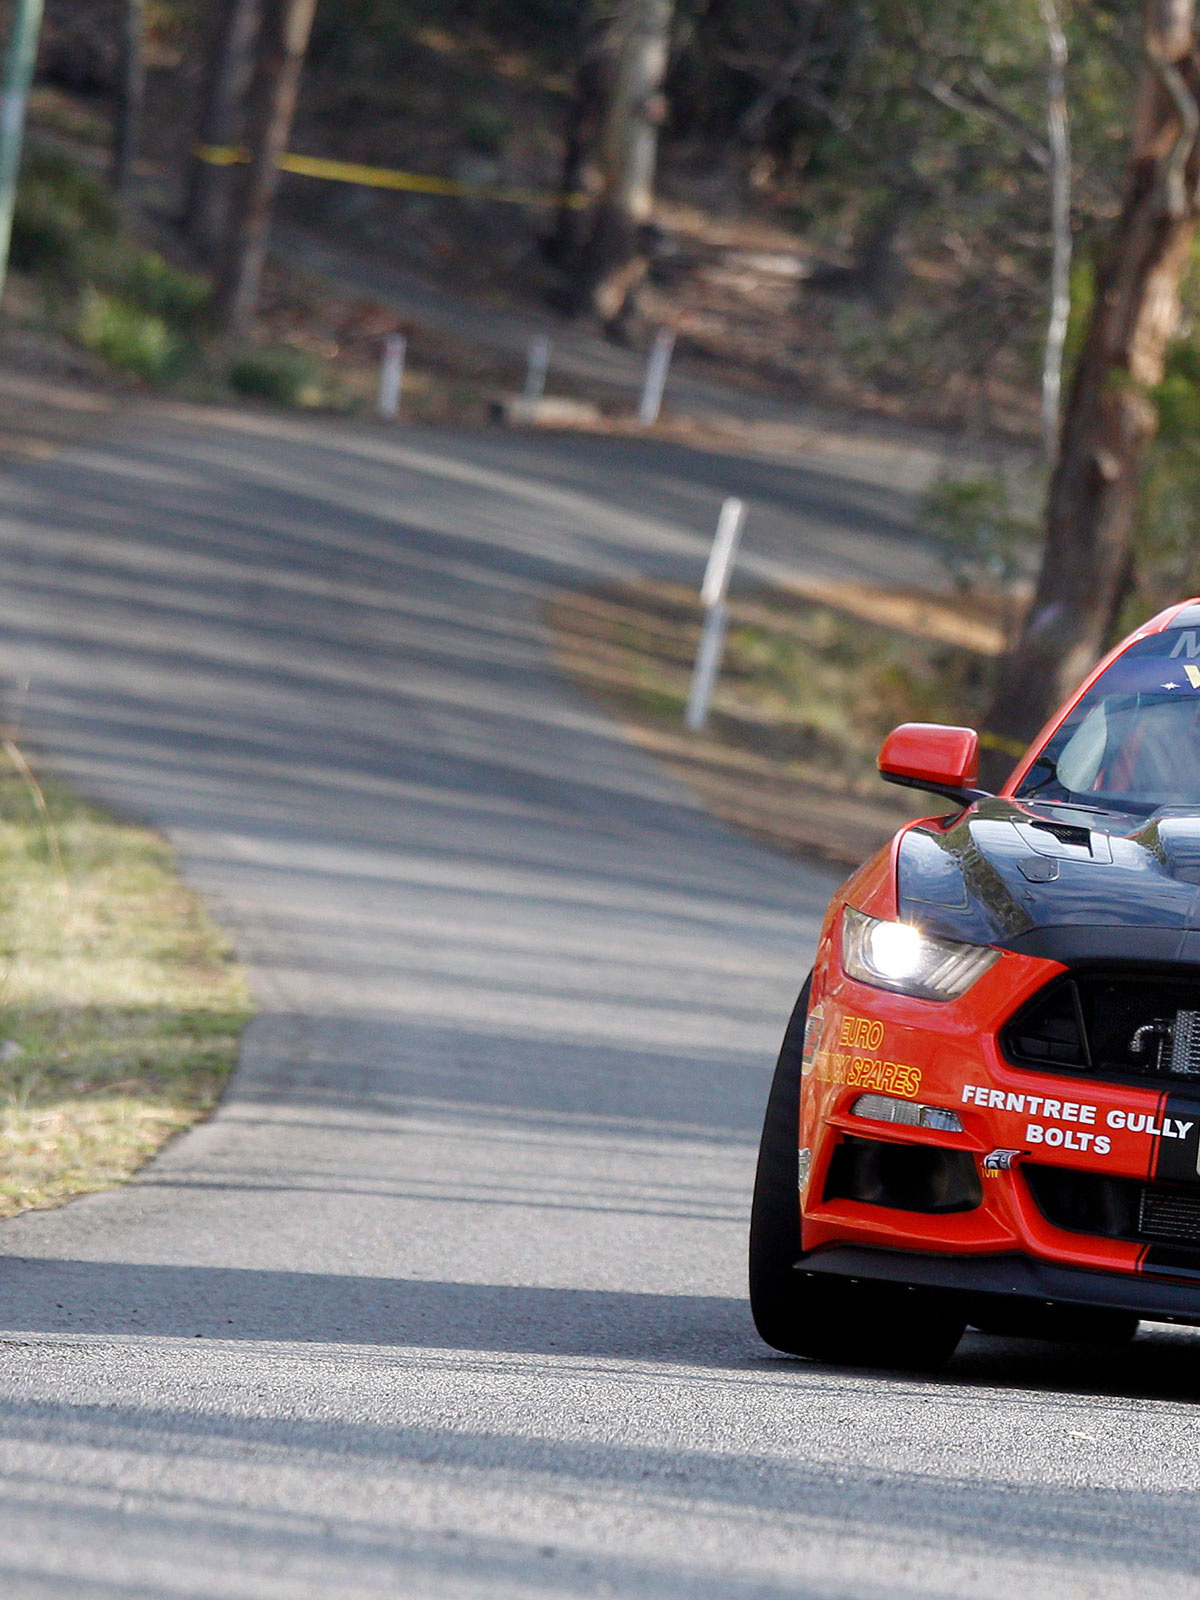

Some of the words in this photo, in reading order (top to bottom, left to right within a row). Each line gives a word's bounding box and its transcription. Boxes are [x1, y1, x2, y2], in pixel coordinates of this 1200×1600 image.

[839, 1015, 884, 1051] EURO
[846, 1056, 923, 1098] SPARES
[961, 1084, 1096, 1125] FERNTREE
[1106, 1109, 1194, 1140] GULLY
[1025, 1123, 1112, 1155] BOLTS
